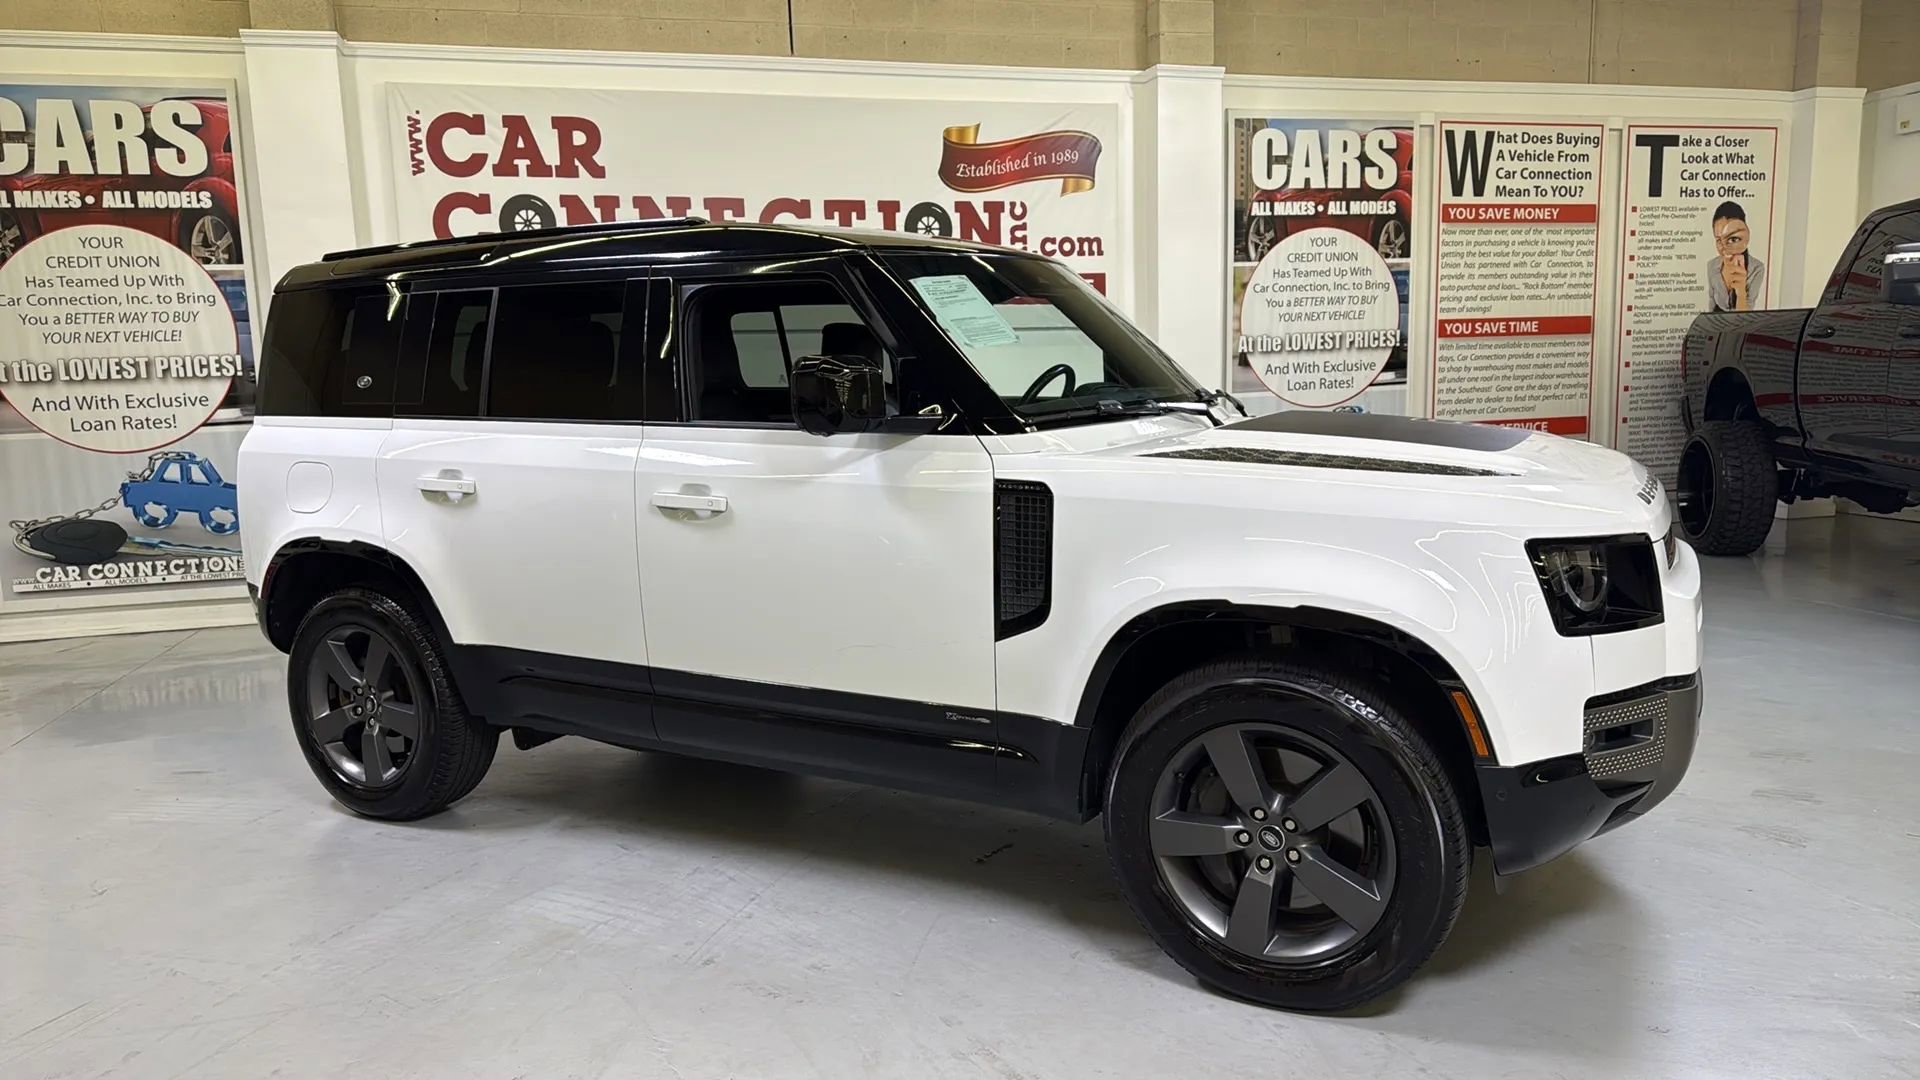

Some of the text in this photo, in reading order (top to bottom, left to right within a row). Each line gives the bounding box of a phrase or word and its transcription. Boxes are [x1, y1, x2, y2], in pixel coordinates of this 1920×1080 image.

[407, 110, 606, 179] www. CAR
[1521, 132, 1553, 144] Does
[1556, 133, 1600, 147] Buying
[1705, 138, 1711, 147] a
[1714, 135, 1750, 147] Closer
[1251, 128, 1398, 190] CARS
[1496, 150, 1590, 162] A Vehicle From
[1681, 152, 1755, 164] Look at What
[956, 149, 1079, 178] Established in 1989
[1495, 167, 1592, 180] Car Connection
[1680, 169, 1766, 181] Car Connection
[1495, 185, 1584, 197] Mean To YOU?
[1680, 185, 1755, 198] Has to Offer...
[13, 190, 82, 208] MAKES
[102, 191, 134, 209] ALL
[138, 191, 213, 208] MODELS
[1251, 201, 1315, 216] ALL MAKES
[1327, 200, 1397, 215] ALL MODELS
[1448, 208, 1560, 220] YOU SAVE MONEY
[1563, 228, 1595, 236] important
[78, 237, 124, 249] YOUR
[1310, 237, 1337, 247] YOUR
[1473, 239, 1510, 248] purchasing
[1547, 239, 1575, 248] knowing
[46, 256, 160, 268] CREDIT UNION
[1287, 251, 1358, 263] CREDIT UNION
[1273, 267, 1372, 279] Has Teamed Up With
[25, 274, 185, 291] Has Teamed Up With
[1253, 280, 1390, 293] Car Connection, Inc. to Bring
[26, 293, 122, 306] Connection,
[126, 292, 152, 305] Inc.
[158, 294, 173, 305] to
[177, 292, 216, 306] Bring
[1265, 298, 1284, 308] You
[1293, 296, 1325, 307] BETTER
[1327, 296, 1346, 306] WAY
[1348, 295, 1360, 305] TO
[1360, 295, 1378, 305] BUY
[19, 310, 200, 326] You a BETTER WAY TO BUY
[1278, 310, 1366, 322] YOUR NEXT VEHICLE!
[1444, 321, 1539, 335] YOU SAVE TIME
[42, 329, 182, 345] YOUR NEXT VEHICLE!
[1238, 330, 1401, 353] At the LOWEST PRICES!
[0, 354, 243, 382] t the LOWEST PRICES!
[1265, 360, 1376, 375] And With Exclusive
[1287, 377, 1354, 391] Loan Rates!
[32, 393, 209, 412] And With Exclusive
[70, 414, 177, 432] Loan Rates!
[1499, 421, 1549, 433] RVICE
[36, 565, 81, 583] CAR
[88, 556, 239, 580] CONNECTION
